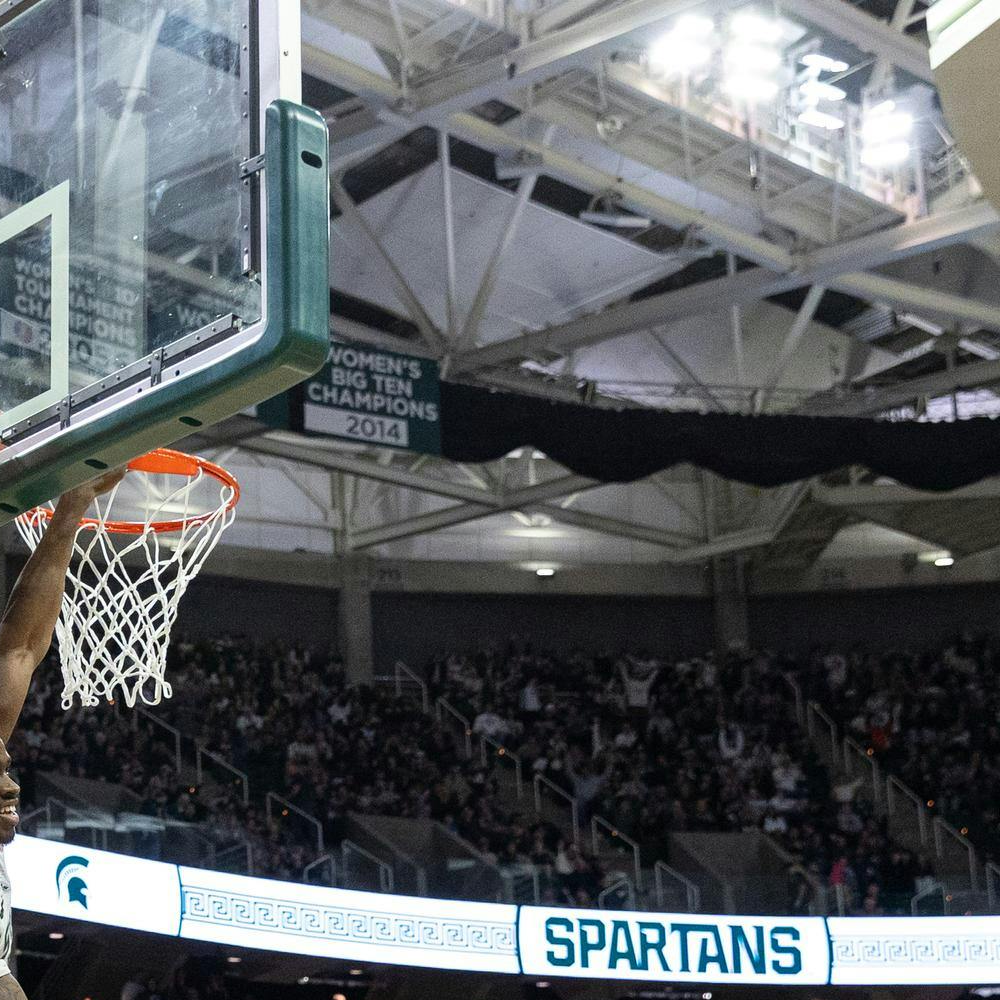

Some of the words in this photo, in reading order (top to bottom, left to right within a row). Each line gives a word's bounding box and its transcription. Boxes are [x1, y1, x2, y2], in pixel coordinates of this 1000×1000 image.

[331, 367, 368, 391] BIG
[372, 373, 413, 399] TEN
[307, 381, 438, 422] CHAMPIONS
[346, 415, 399, 441] 2014
[545, 917, 802, 975] SPARTANS
